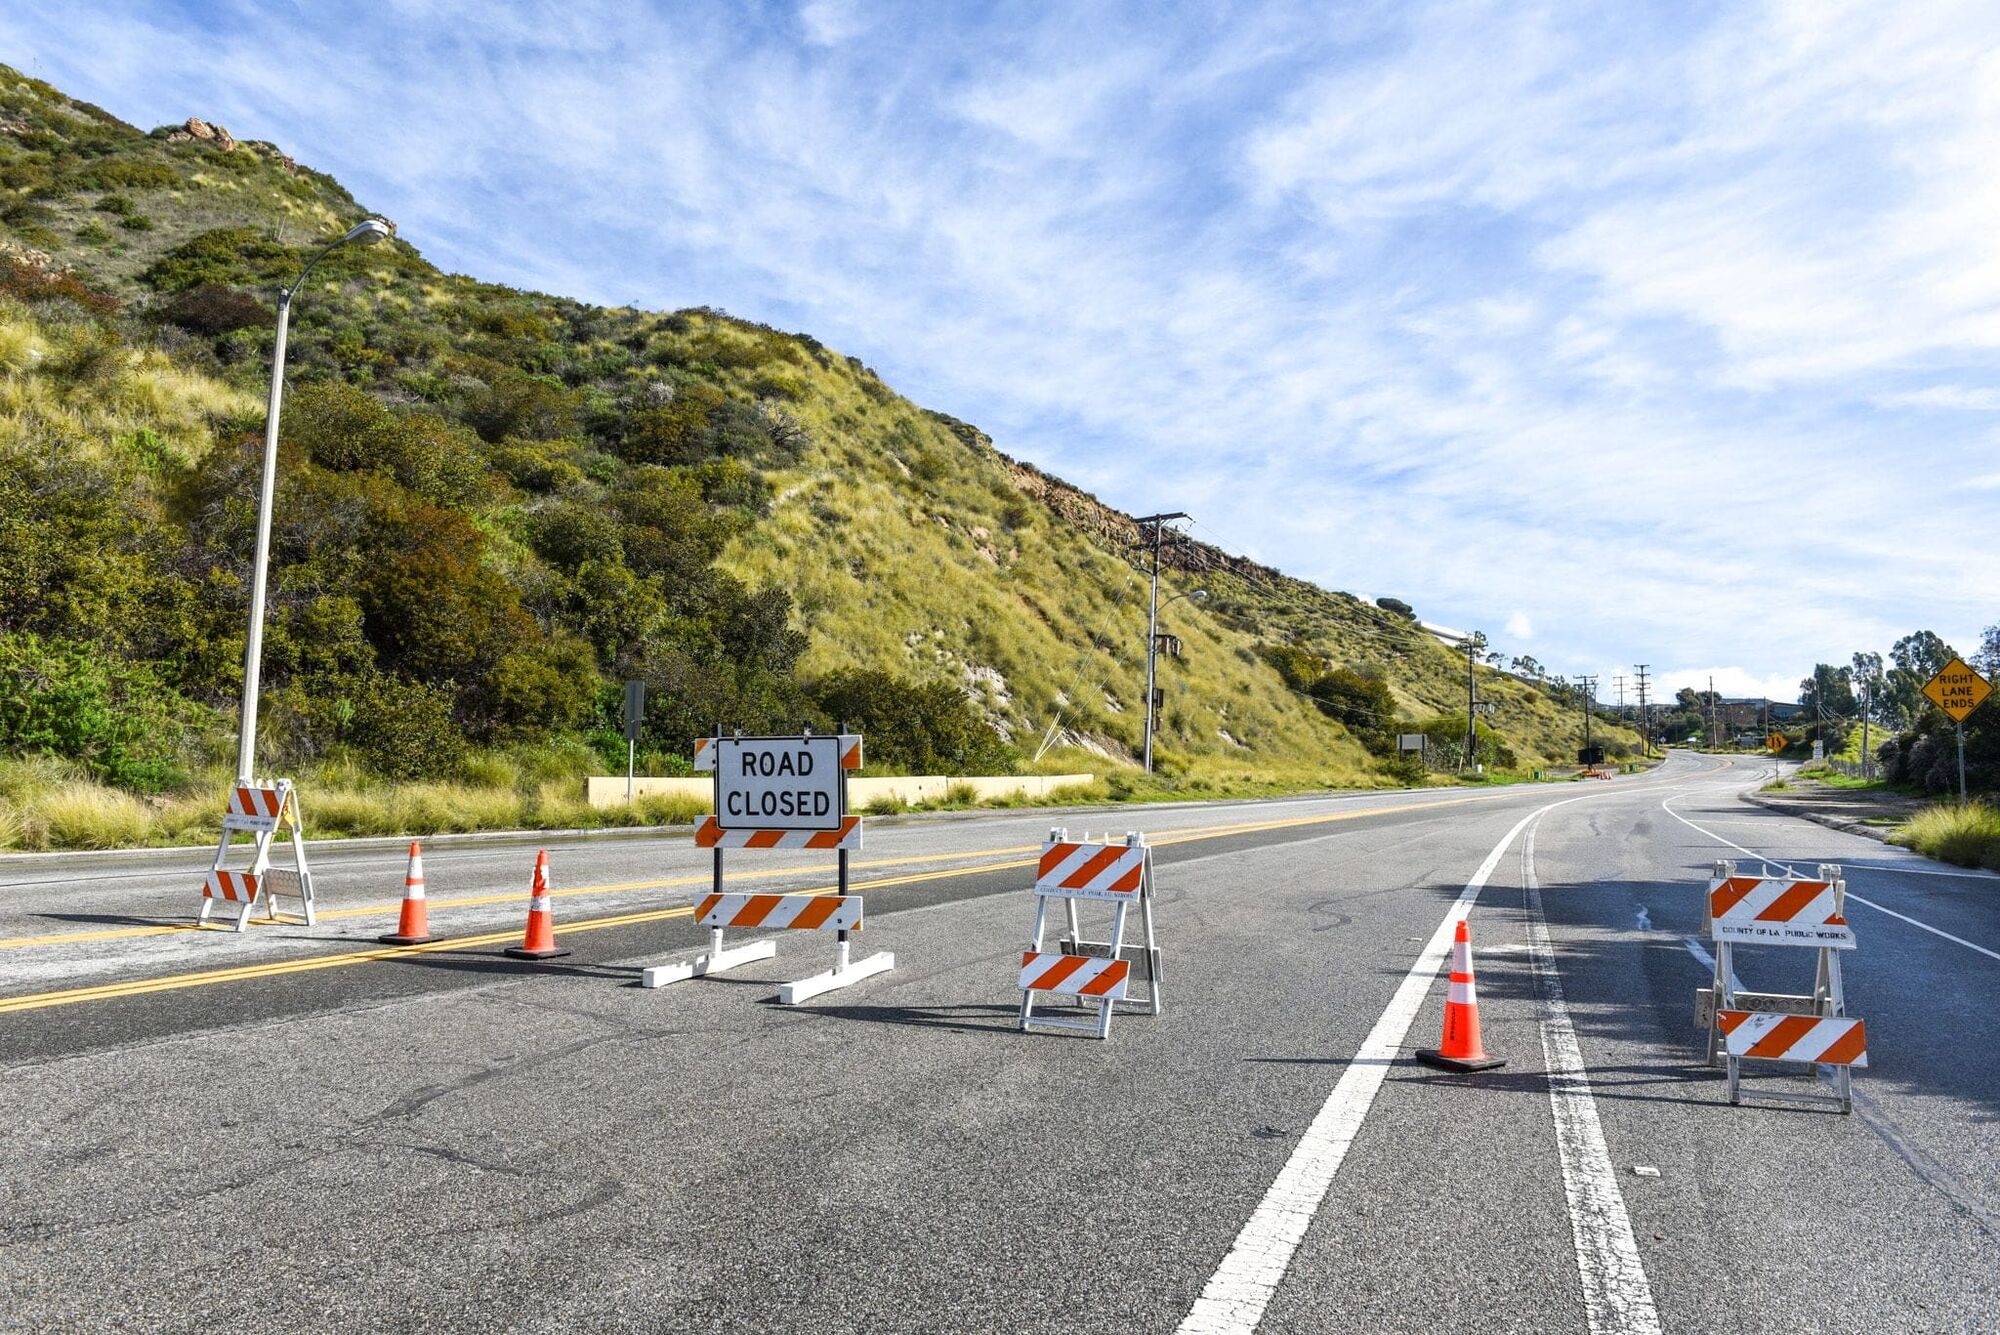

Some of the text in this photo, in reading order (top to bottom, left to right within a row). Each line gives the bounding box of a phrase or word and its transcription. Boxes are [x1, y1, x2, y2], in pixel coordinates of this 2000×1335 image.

[1939, 674, 1974, 684] RIGHT
[1941, 686, 1974, 697] LANE
[1943, 698, 1975, 709] ENDS
[742, 751, 814, 777] ROAD
[727, 790, 830, 816] CLOSED
[1722, 926, 1753, 935] COUNTY
[1769, 929, 1780, 937] LA
[1785, 930, 1813, 938] PUBLIC
[1816, 931, 1847, 940] WORKS
